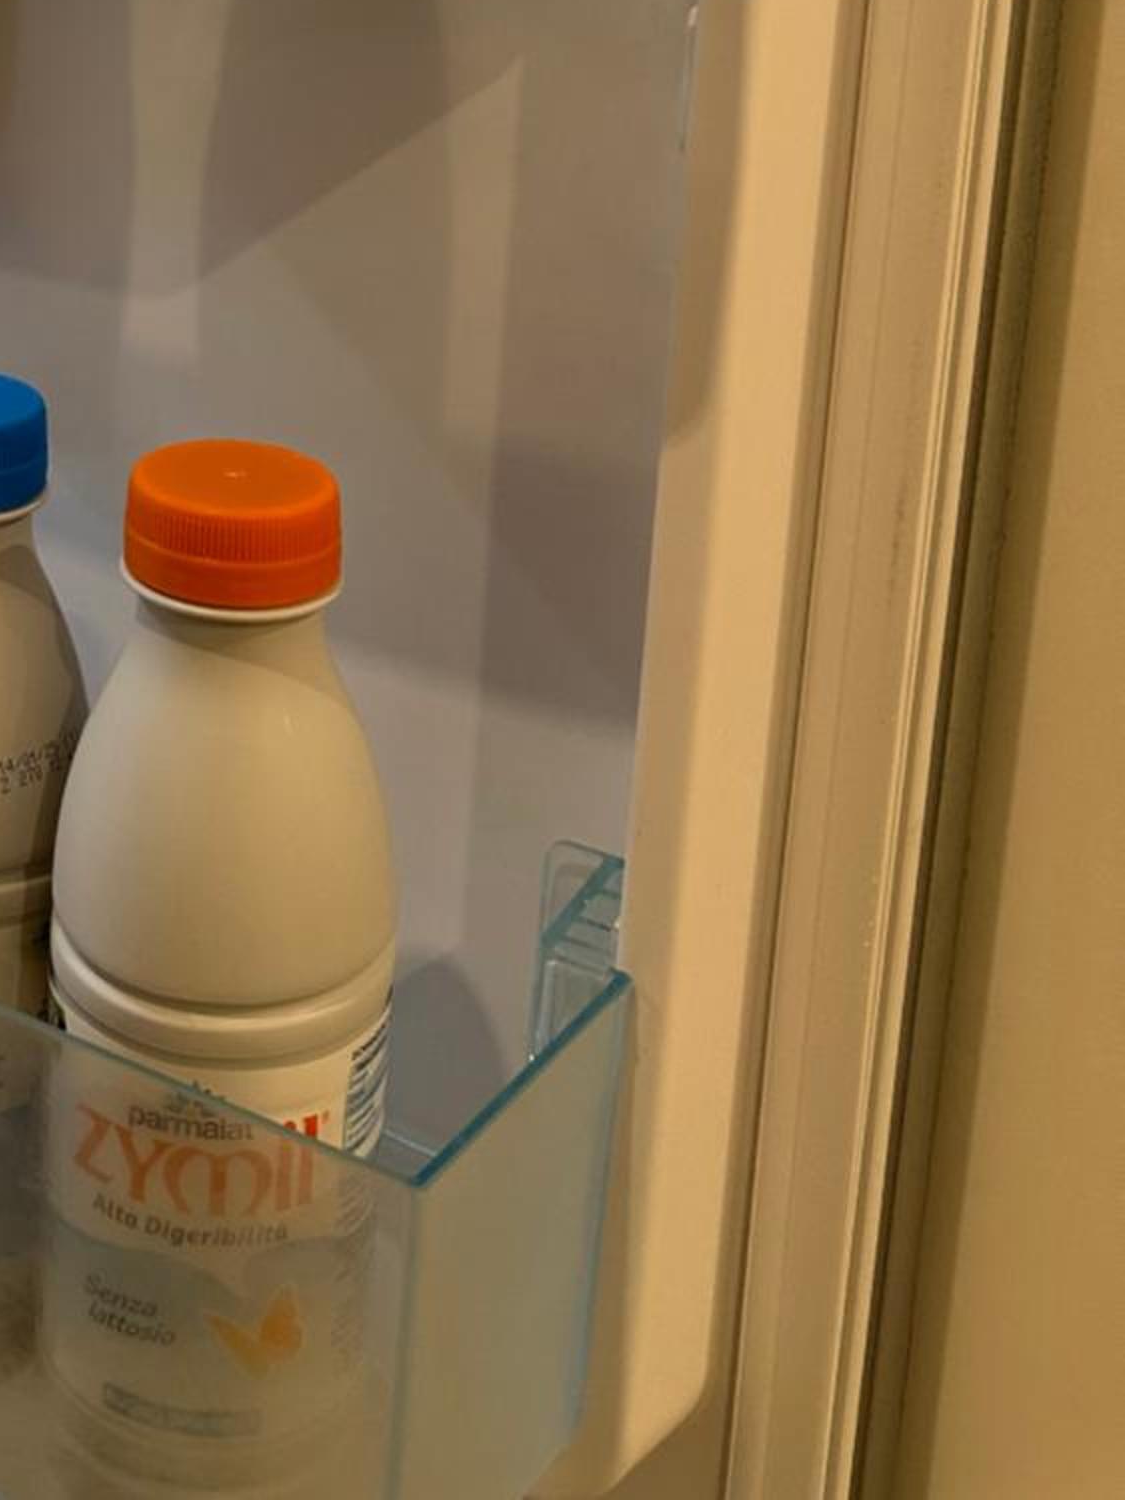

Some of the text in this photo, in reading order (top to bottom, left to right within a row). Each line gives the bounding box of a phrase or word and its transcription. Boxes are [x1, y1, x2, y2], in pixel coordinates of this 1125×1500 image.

[127, 1102, 255, 1142] parmalat
[84, 1271, 159, 1318] Senza
[88, 1298, 177, 1347] lattosio
